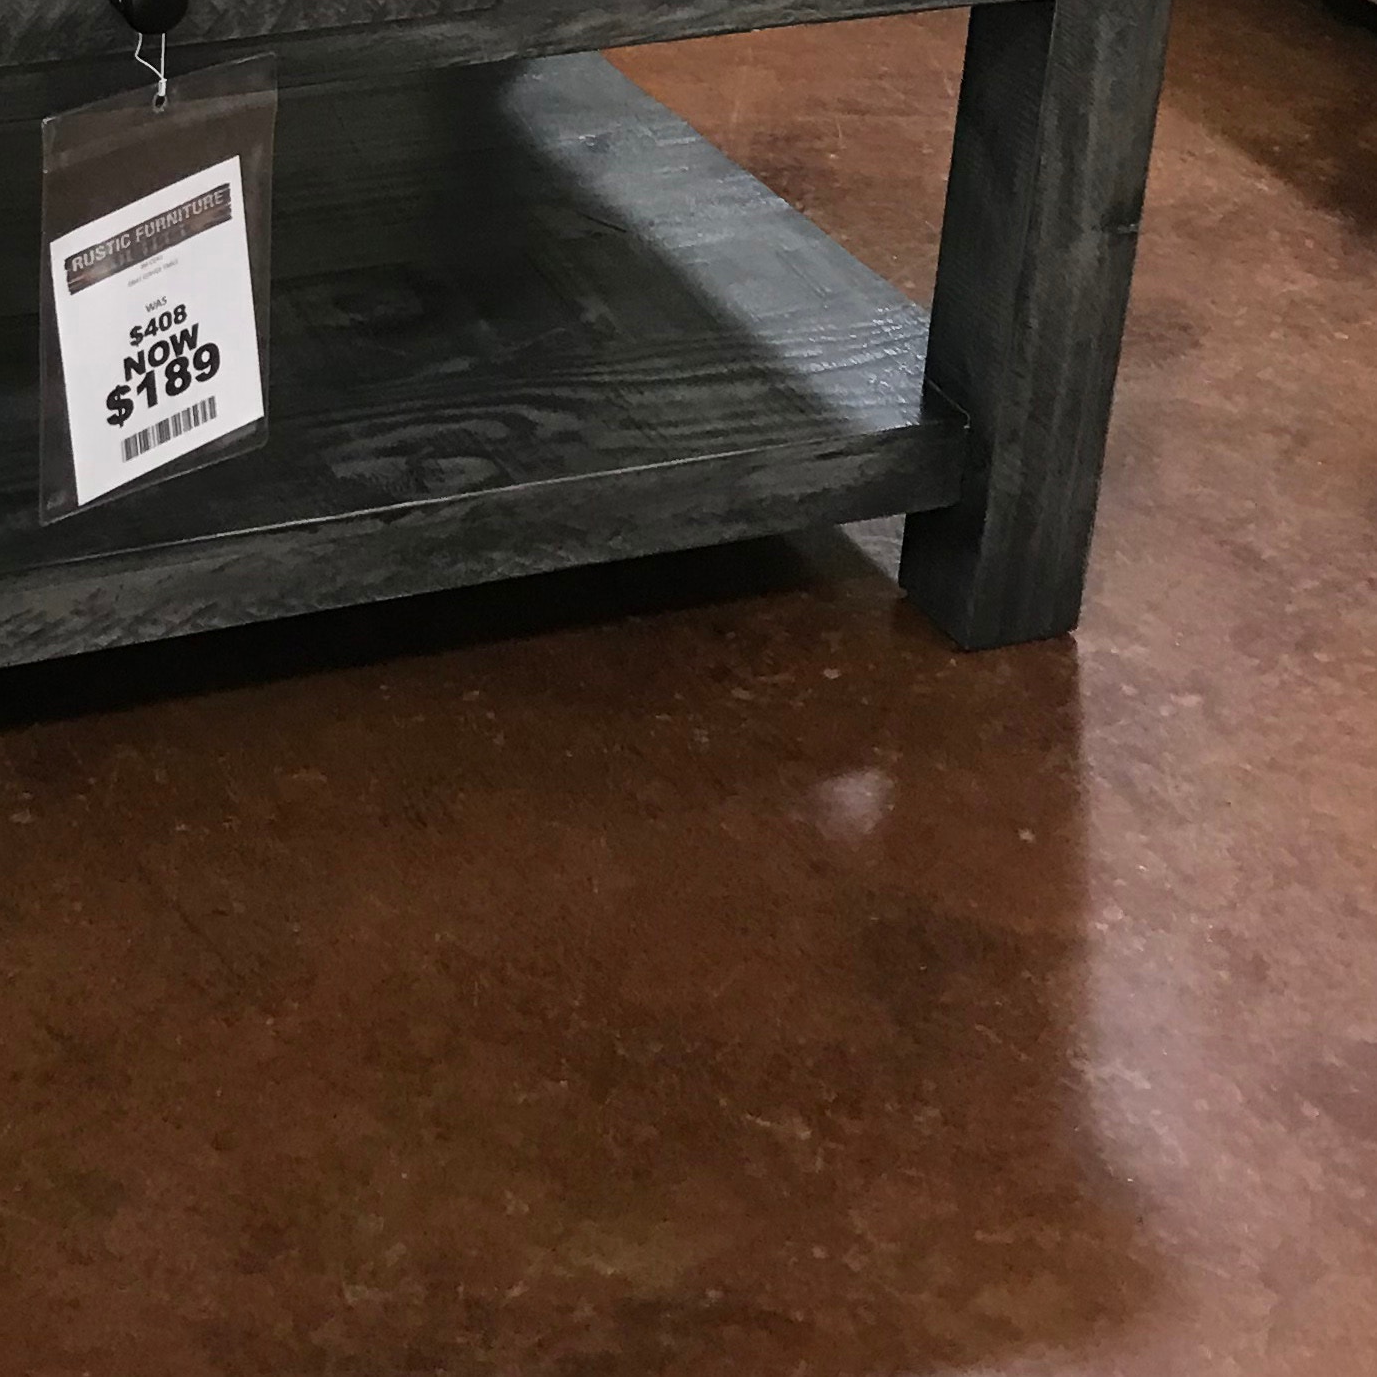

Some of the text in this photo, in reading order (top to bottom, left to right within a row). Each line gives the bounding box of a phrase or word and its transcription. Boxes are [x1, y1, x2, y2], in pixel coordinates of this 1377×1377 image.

[71, 232, 131, 272] RUSTIC
[135, 191, 225, 243] FURNITURE
[129, 303, 188, 347] $408
[145, 295, 168, 313] WAS
[123, 323, 200, 381] NOW
[106, 342, 221, 428] $189
